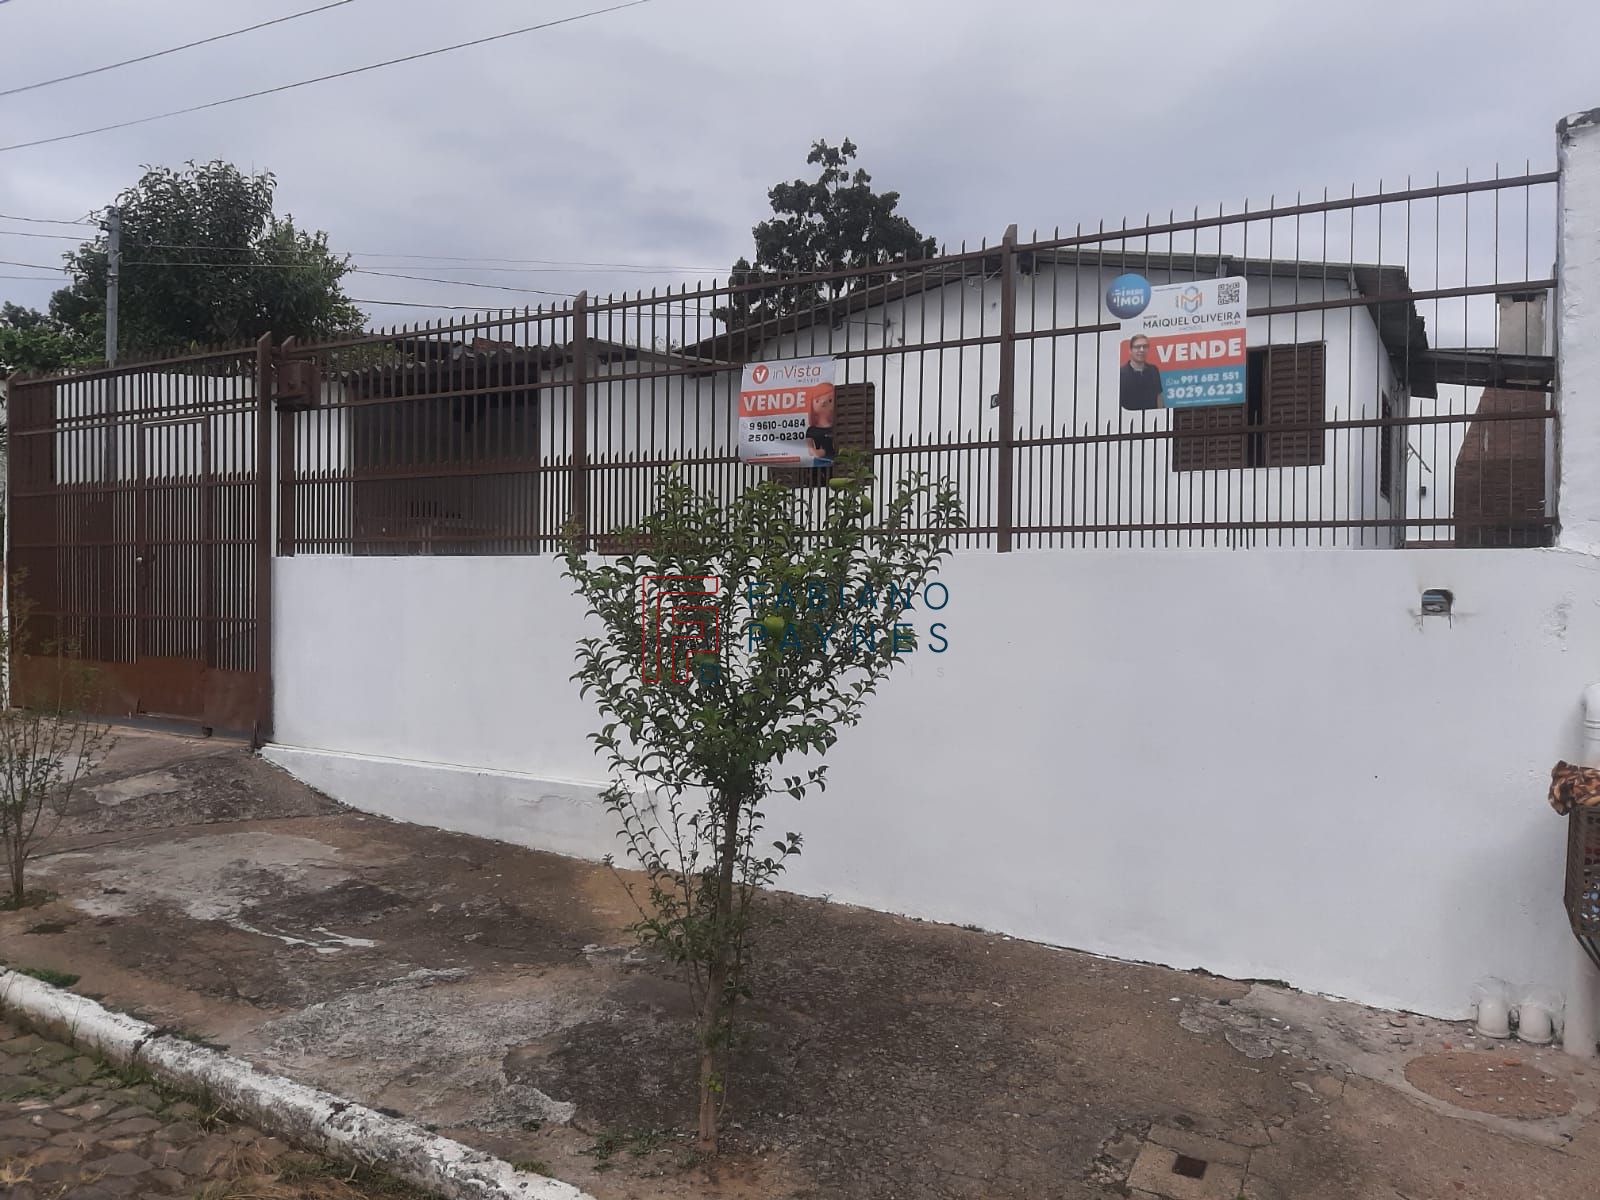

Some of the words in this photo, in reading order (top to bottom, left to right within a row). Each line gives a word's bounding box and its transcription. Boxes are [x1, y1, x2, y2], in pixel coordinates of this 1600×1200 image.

[1142, 316, 1189, 329] MAIQUEL
[1192, 311, 1241, 324] OLIVEIRA
[1156, 337, 1242, 363] VENDE
[772, 364, 821, 380] inVista
[1166, 382, 1243, 399] 3029.6223
[743, 391, 807, 412] VENDE
[757, 418, 806, 431] 9610-0484
[748, 431, 805, 442] 2500-0230
